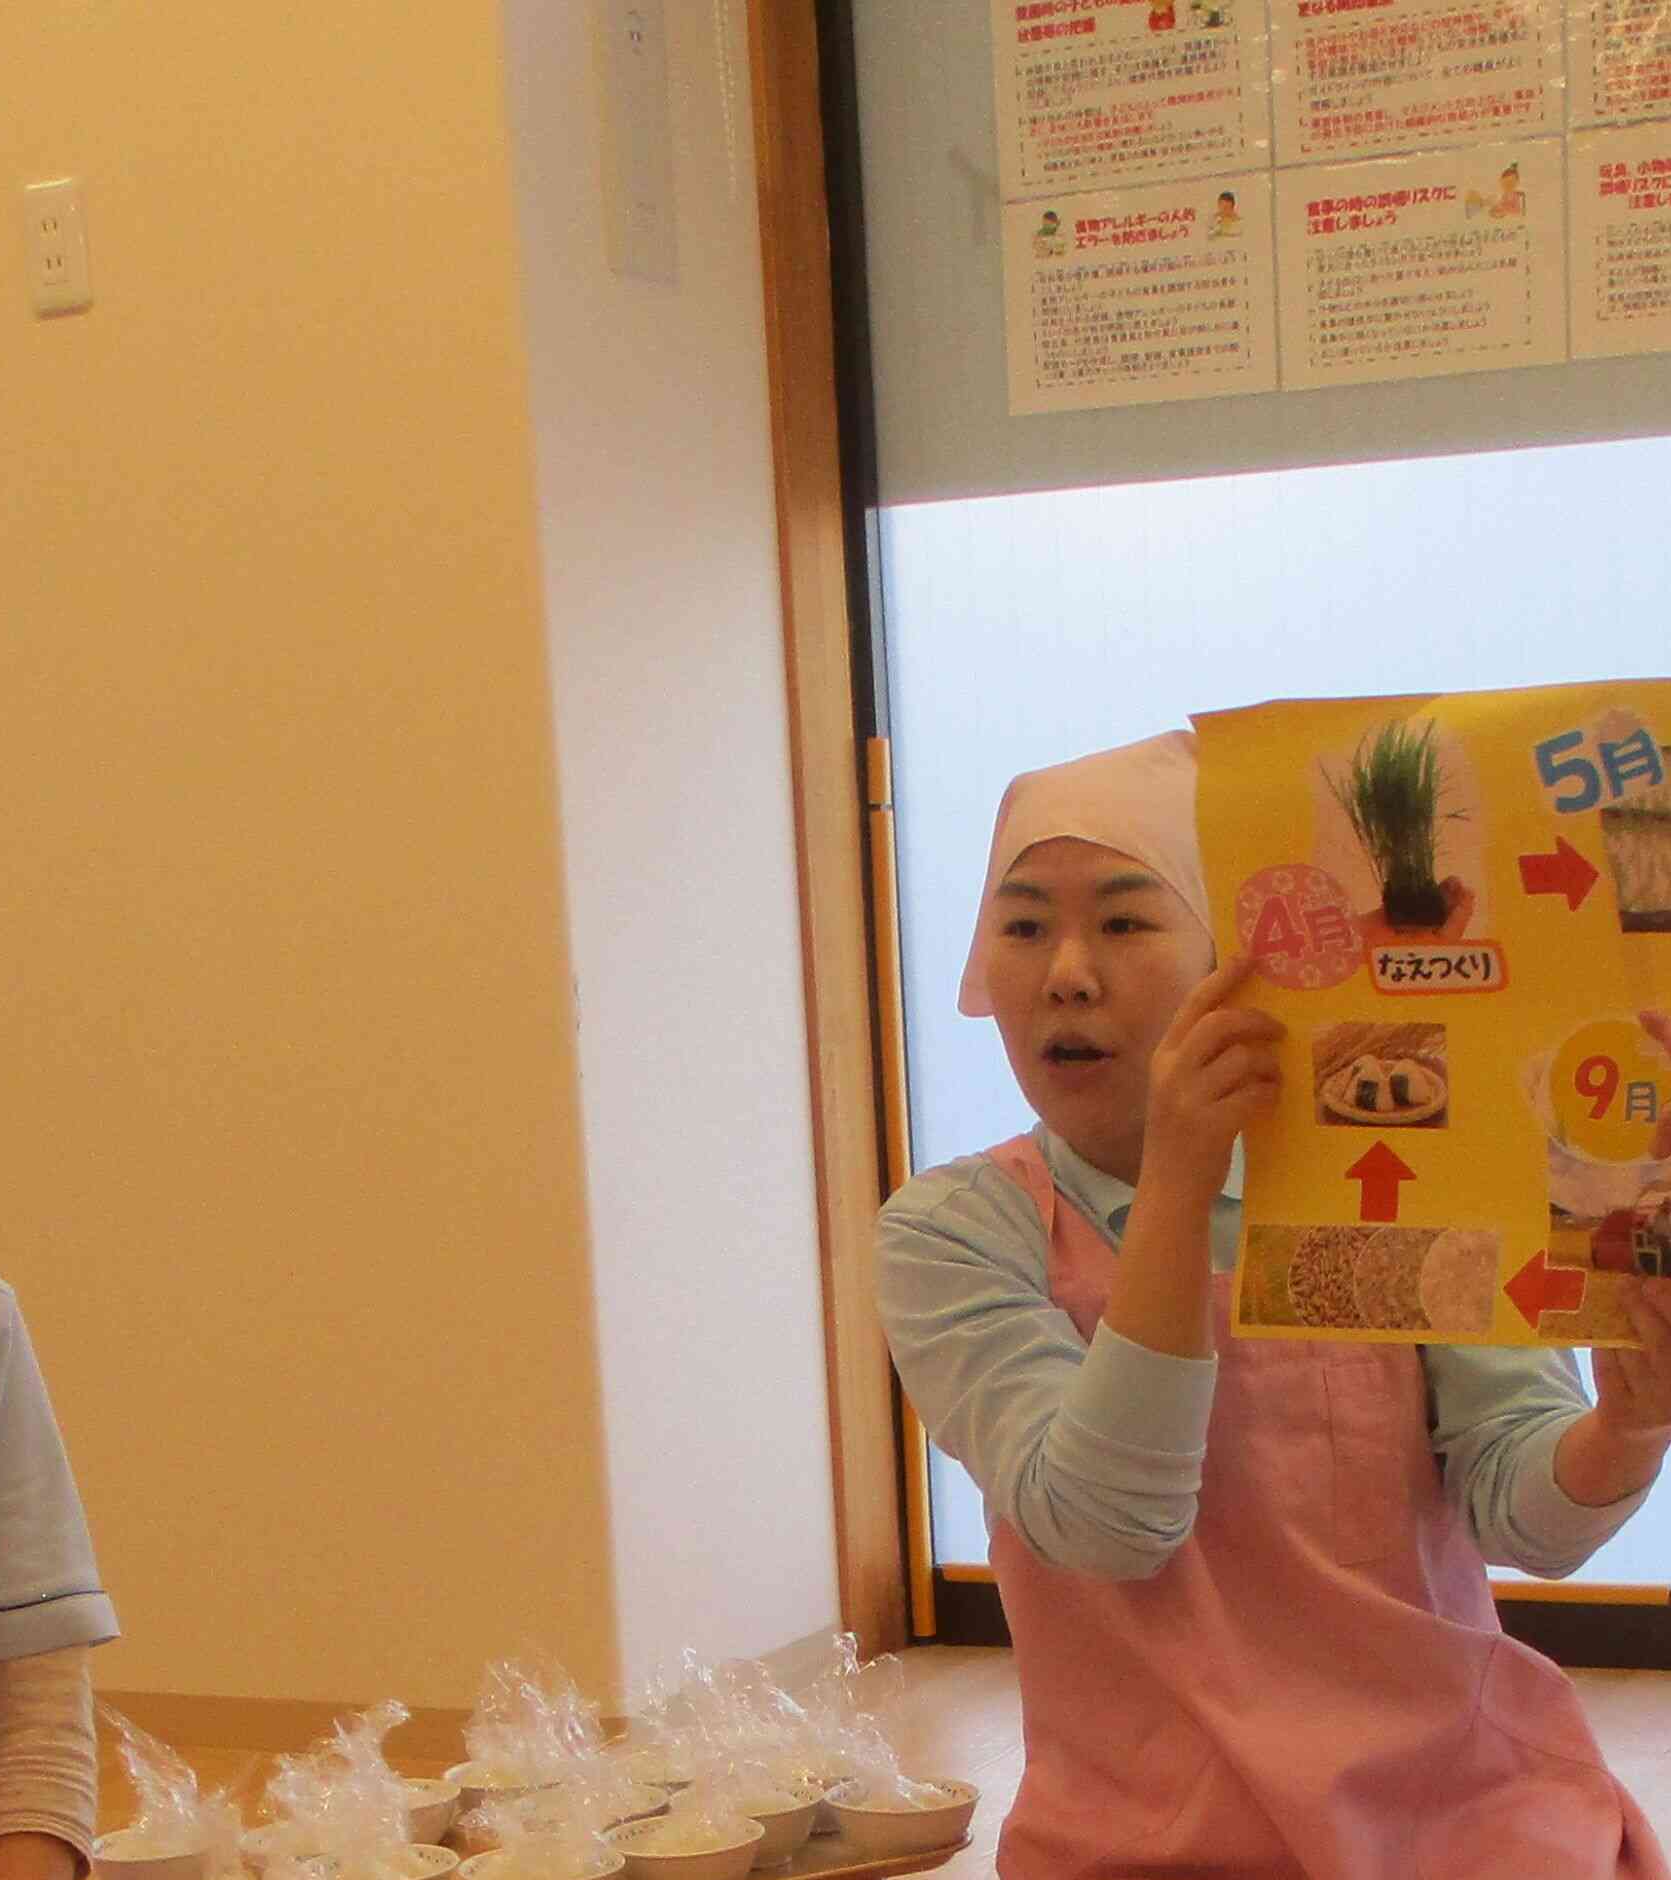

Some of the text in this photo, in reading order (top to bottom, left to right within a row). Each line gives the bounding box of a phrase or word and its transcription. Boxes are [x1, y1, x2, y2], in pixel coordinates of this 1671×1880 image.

[1535, 728, 1664, 813] 5月
[1253, 895, 1353, 959] 4月
[1377, 952, 1491, 982] なえつくり
[1574, 1055, 1657, 1123] 9月
